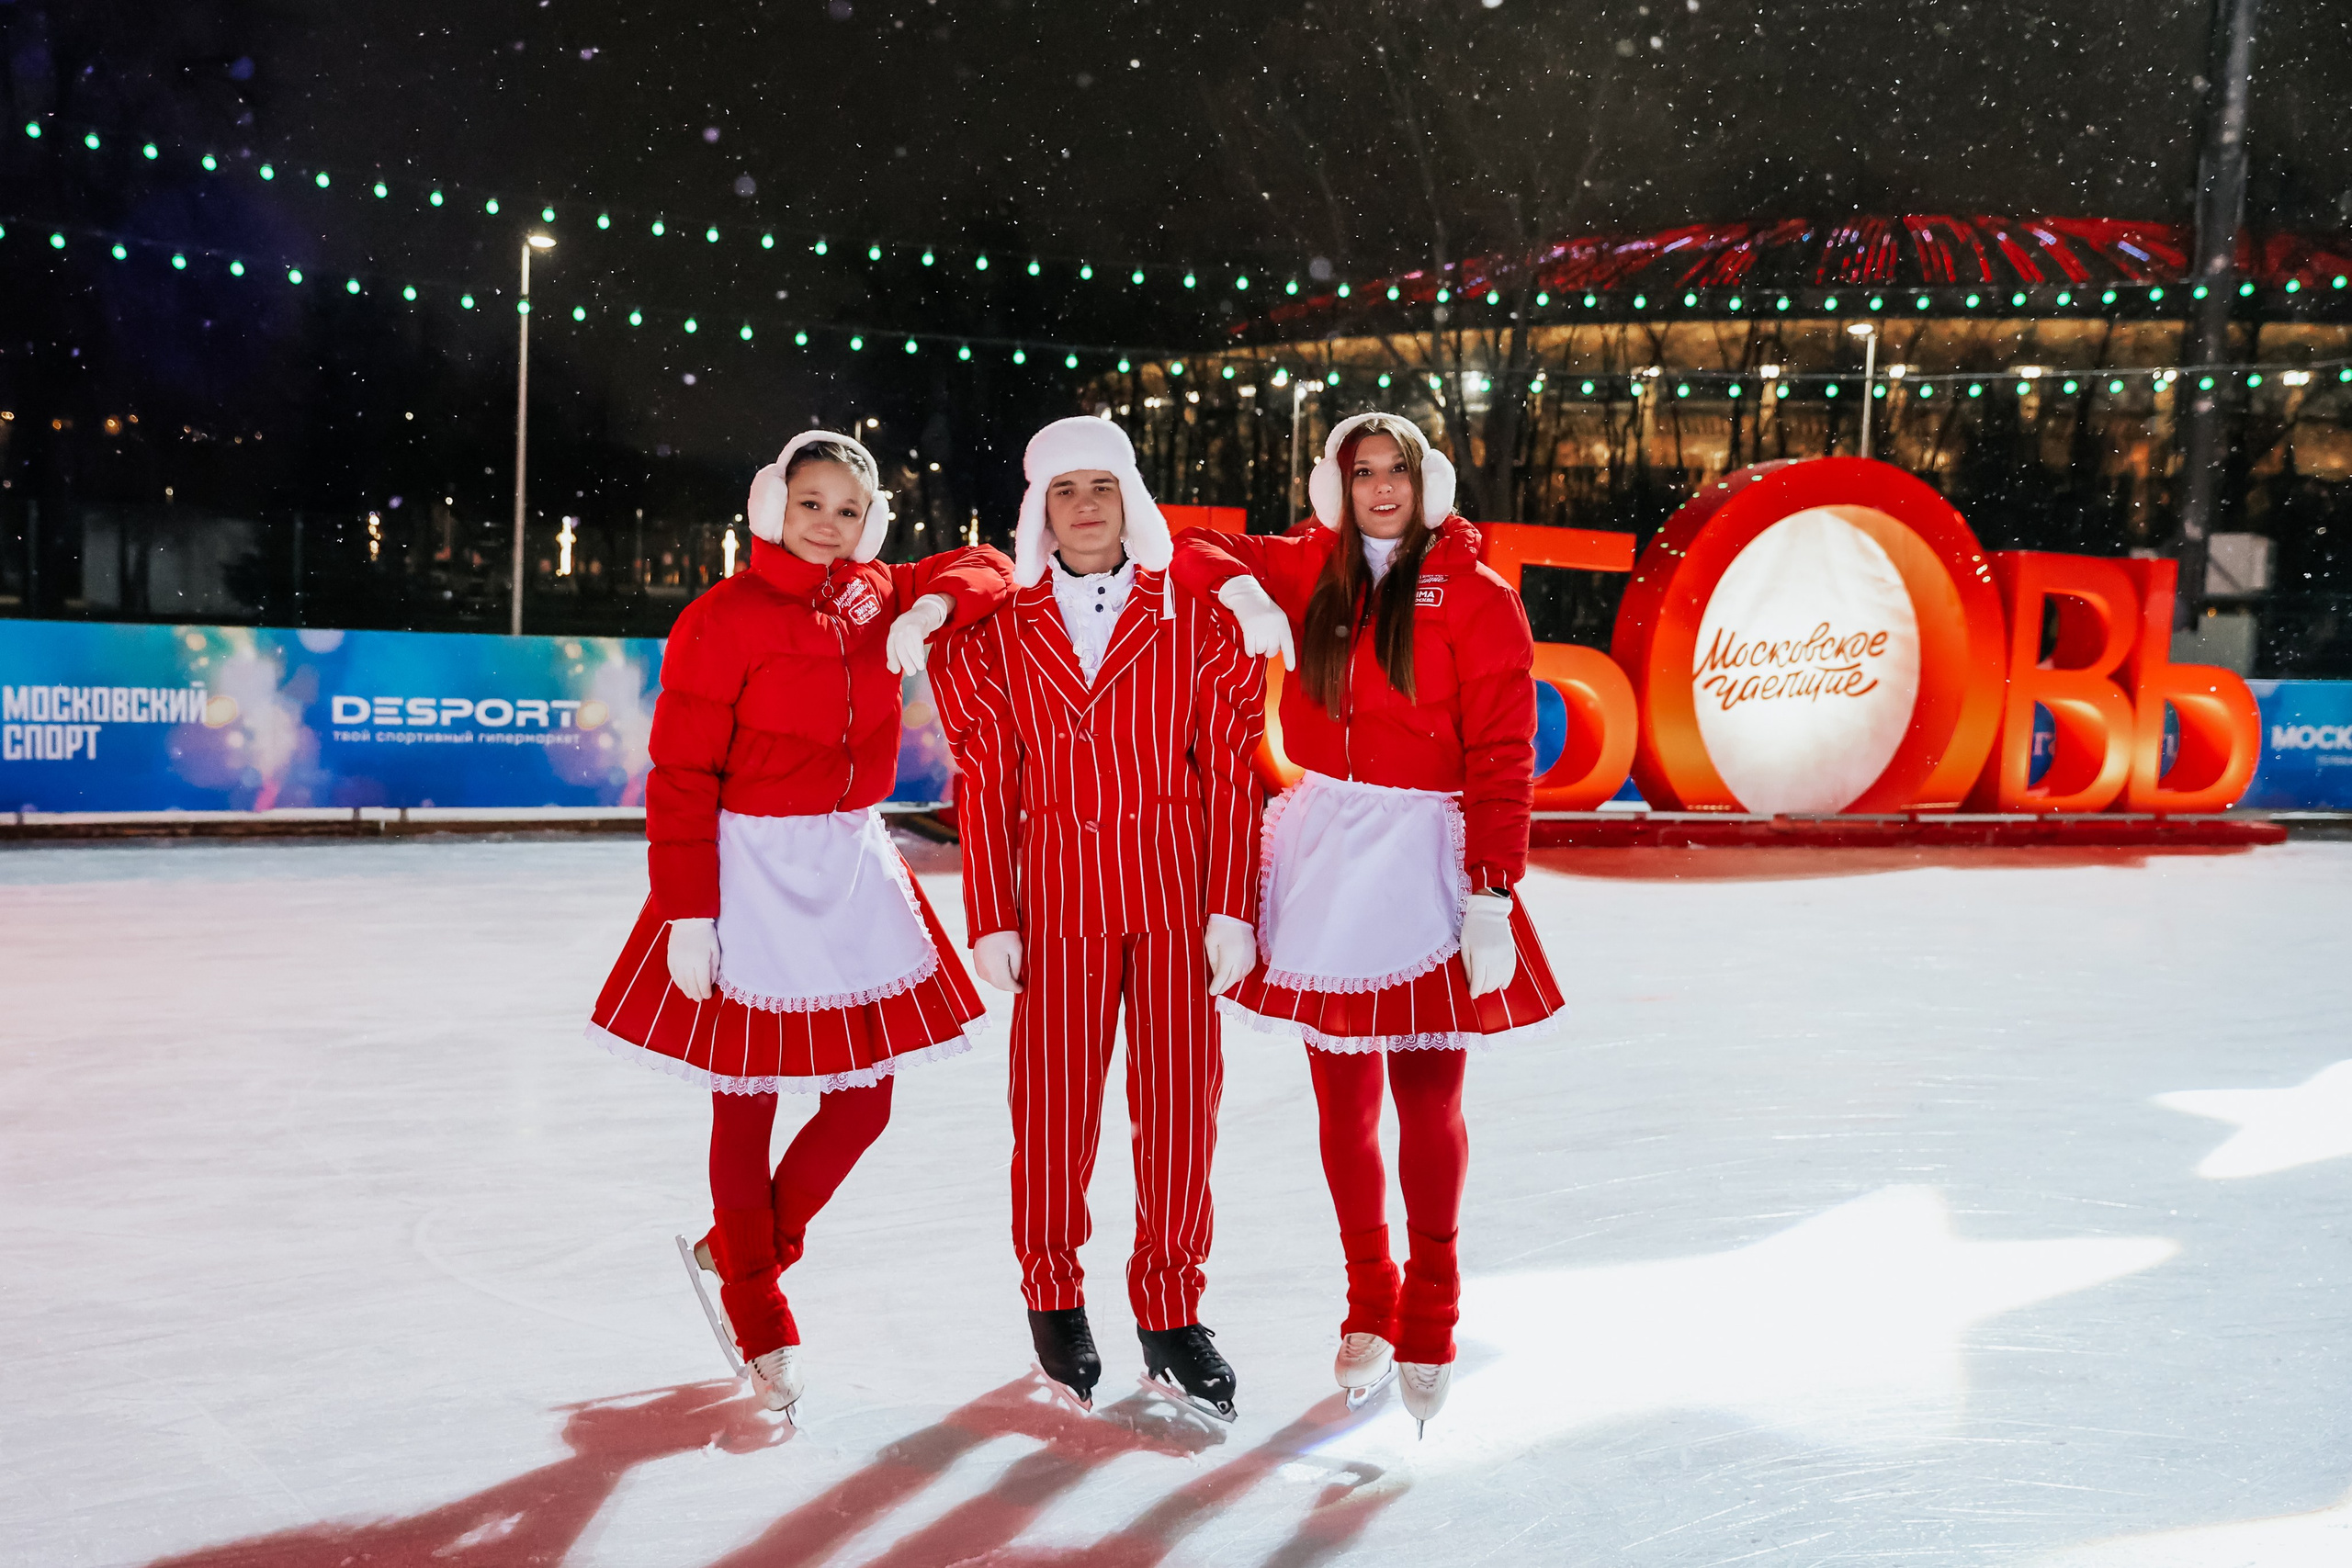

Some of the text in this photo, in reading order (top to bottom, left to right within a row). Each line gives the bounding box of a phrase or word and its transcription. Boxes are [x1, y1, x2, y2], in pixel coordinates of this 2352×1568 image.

[854, 600, 876, 616] ЗИМА
[1159, 457, 2262, 818] БОВЬ
[1692, 622, 1888, 682] Московское
[3, 681, 208, 723] МОСКОВСКИЙ
[1702, 662, 1879, 711] чаепитие
[332, 695, 582, 728] DESPORT
[3, 724, 102, 761] СПОРТ
[334, 728, 370, 743] твой
[375, 729, 474, 746] спортивный
